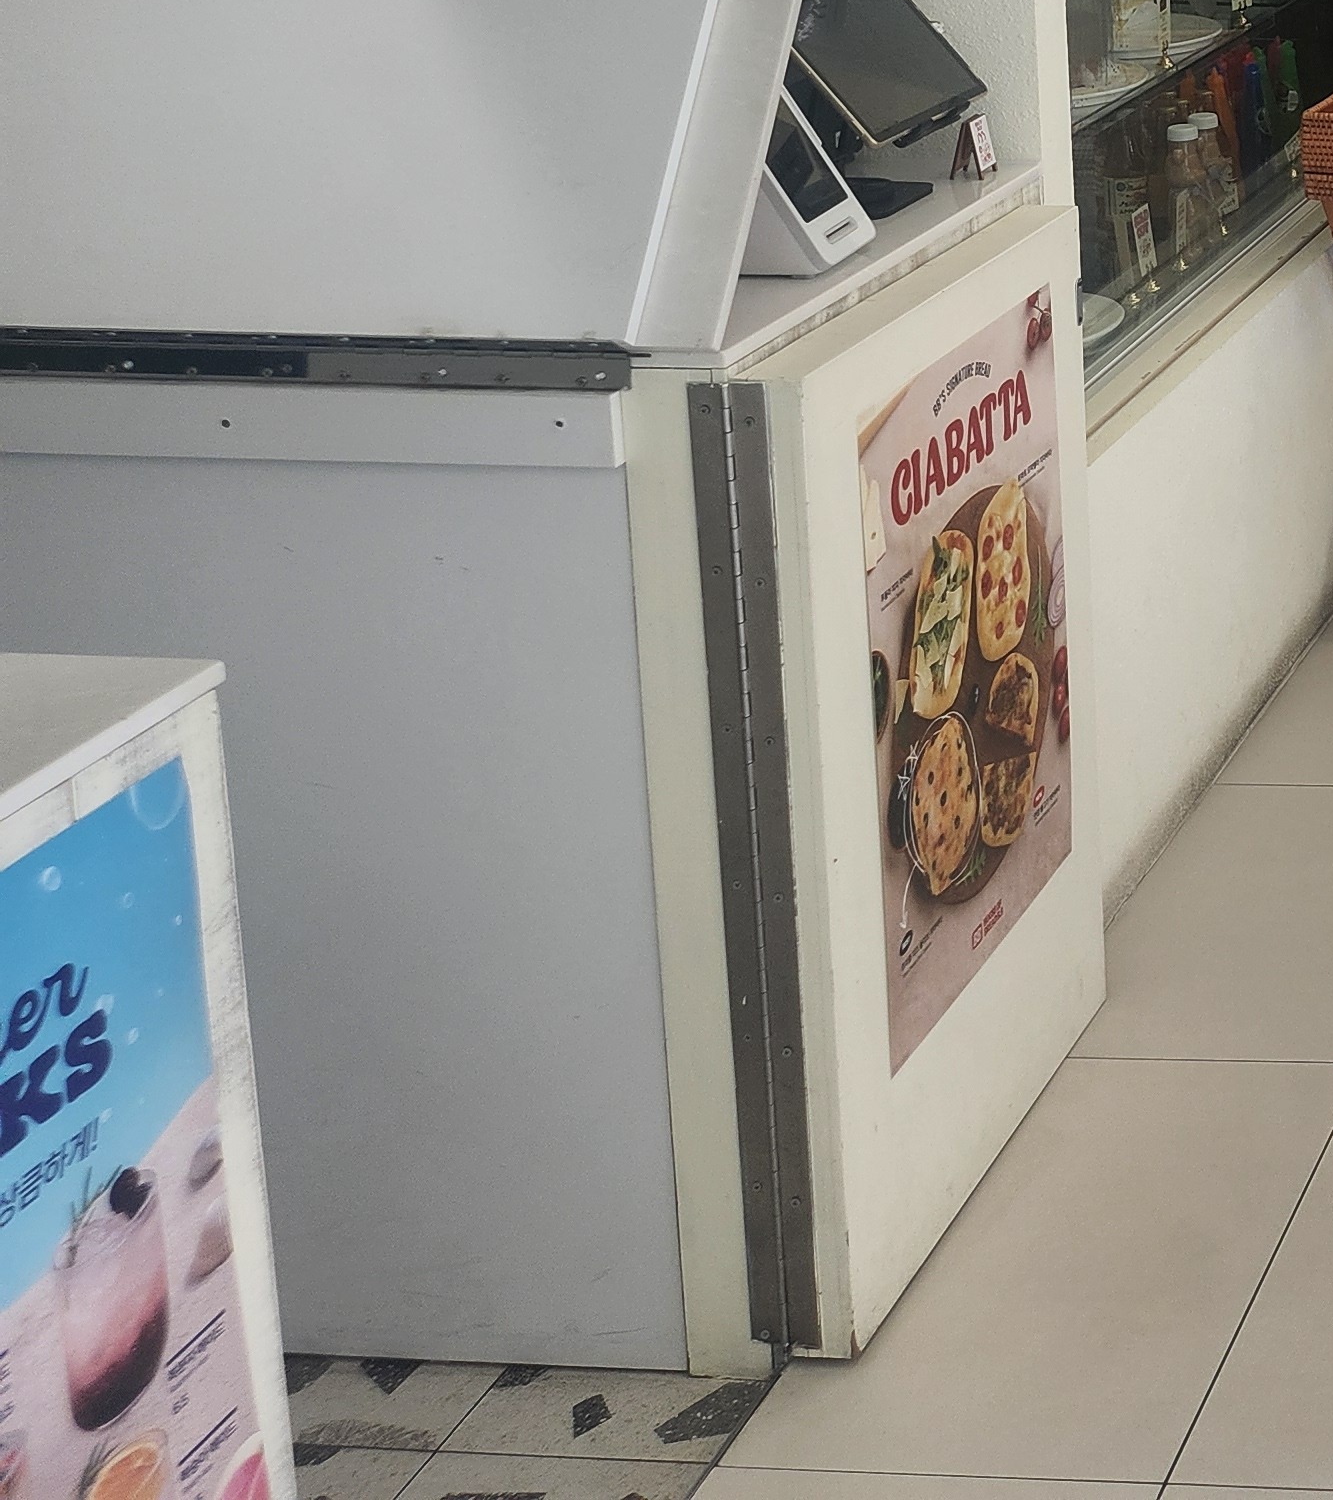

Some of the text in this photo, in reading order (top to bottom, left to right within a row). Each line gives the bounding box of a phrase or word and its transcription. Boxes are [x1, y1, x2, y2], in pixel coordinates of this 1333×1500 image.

[946, 361, 974, 396] SIGNATURE
[890, 369, 1032, 526] CIABATTA
[0, 962, 89, 1052] er
